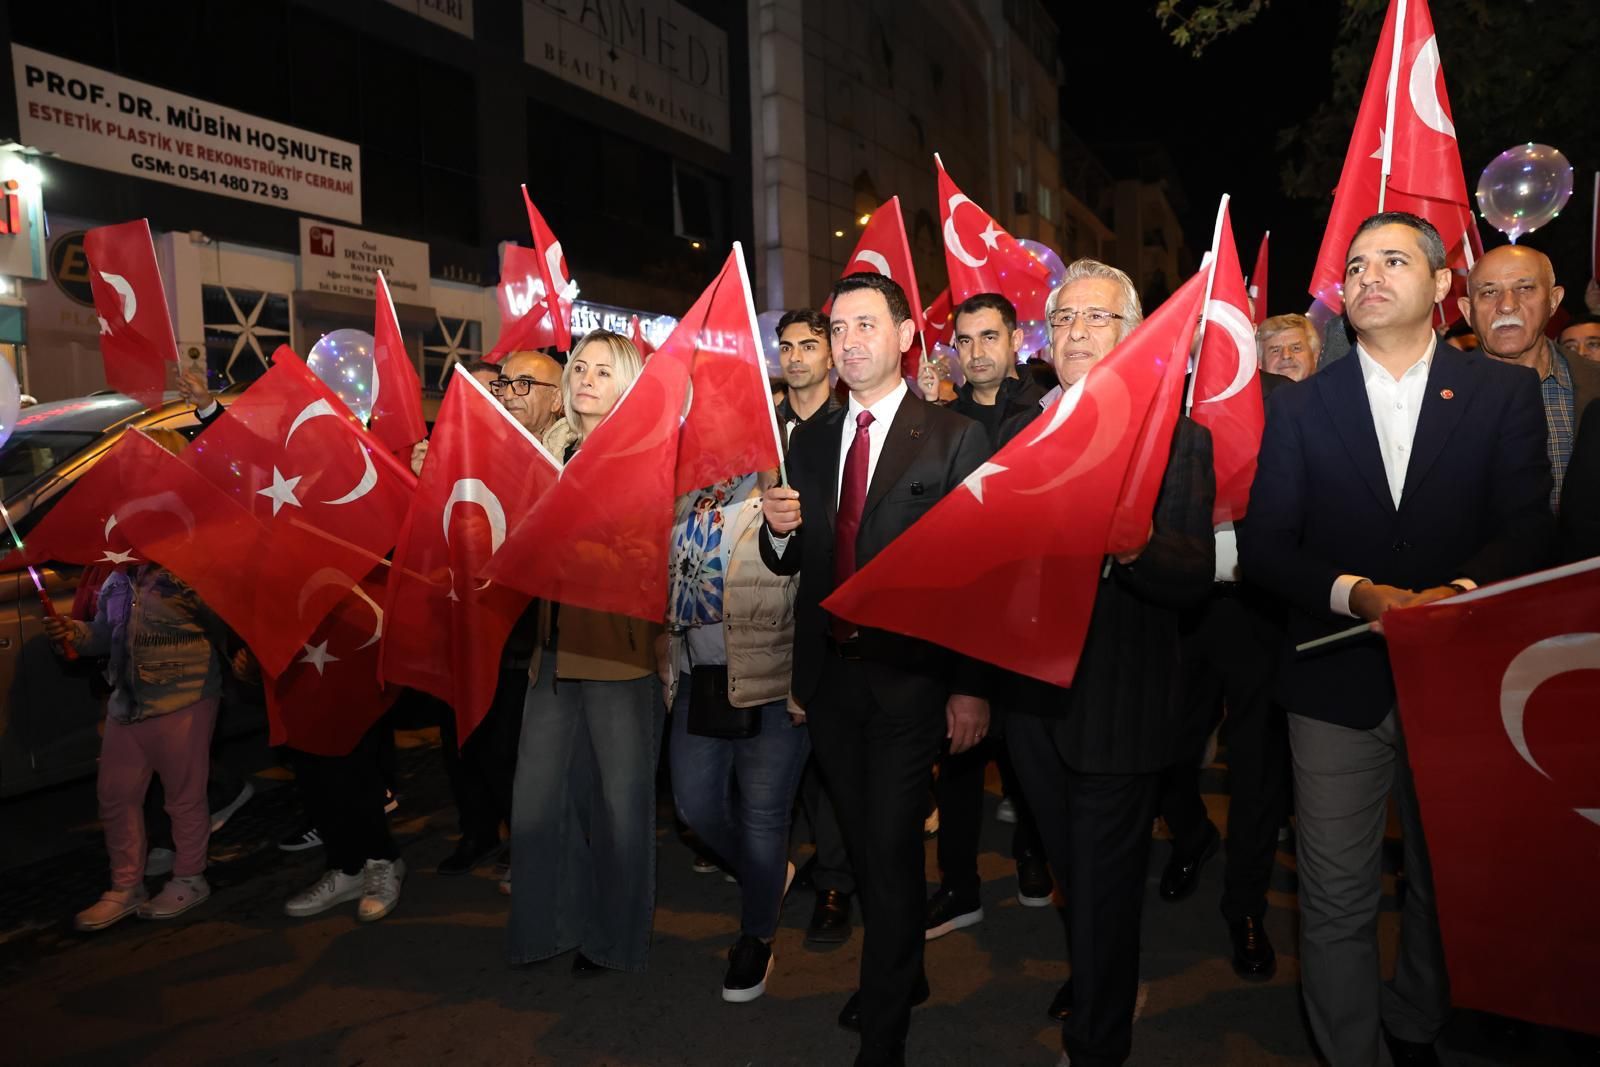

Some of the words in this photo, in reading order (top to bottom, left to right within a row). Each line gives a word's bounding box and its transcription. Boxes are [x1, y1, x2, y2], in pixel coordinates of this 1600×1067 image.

[544, 42, 619, 92] BEAUTY
[628, 84, 639, 102] &
[25, 64, 112, 108] PROF.
[118, 91, 161, 122] DR.
[167, 104, 242, 143] MÜBİN
[247, 127, 353, 173] HOŞNUTER
[28, 101, 103, 135] ESTETİK
[106, 121, 172, 152] PLASTİK
[175, 140, 195, 158] VE
[196, 145, 304, 182] REKONSTRÜKTİF
[304, 172, 354, 196] CERRAHİ
[131, 152, 175, 177] GSM:
[178, 164, 217, 185] 0541
[219, 173, 250, 194] 480
[251, 180, 270, 197] 72
[271, 185, 289, 201] 93
[343, 248, 395, 267] DENTAFİX
